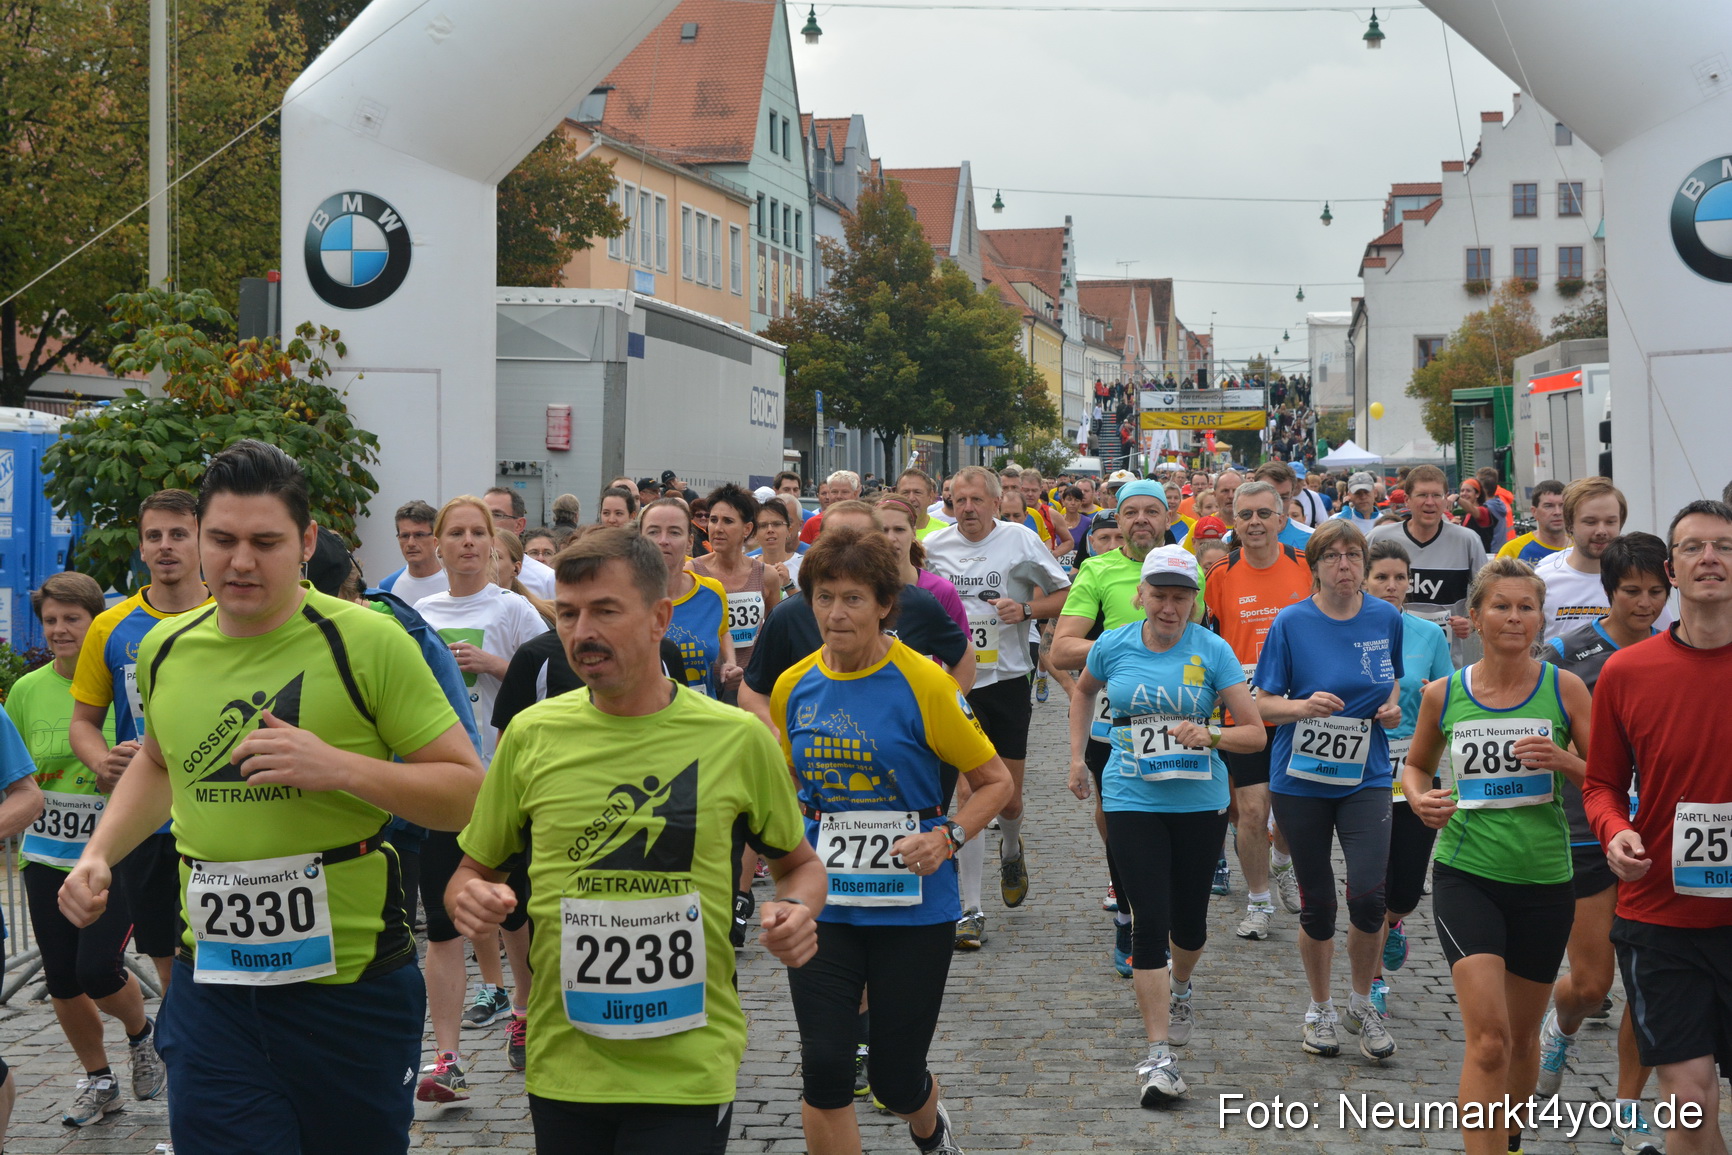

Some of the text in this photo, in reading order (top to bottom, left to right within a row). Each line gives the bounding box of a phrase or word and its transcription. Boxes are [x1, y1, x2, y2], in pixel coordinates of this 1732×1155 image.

[311, 194, 403, 233] BMW
[751, 386, 779, 430] BOCK
[1181, 415, 1224, 426] START
[949, 574, 984, 586] Allianz
[1405, 572, 1444, 600] sky
[1239, 595, 1257, 605] DAK
[1130, 684, 1202, 713] ANY
[1133, 715, 1158, 726] PARTL
[1299, 717, 1359, 732] PARTL Neumarkt
[1140, 725, 1204, 755] 21
[1455, 727, 1534, 740] PARTL Neumarkt
[183, 714, 238, 774] GOSSEN
[1300, 729, 1363, 760] 2267
[1149, 757, 1199, 771] Hannelore
[1462, 740, 1540, 775] 289
[1316, 763, 1338, 776] Anni
[1484, 781, 1524, 796] Gisela
[53, 799, 91, 810] Neumarkt
[33, 808, 97, 839] 3394
[822, 820, 902, 831] PARTL Neumarkt
[1677, 812, 1710, 823] PARTL
[567, 799, 628, 863] GOSSEN
[1684, 827, 1732, 862] 25
[192, 869, 299, 886] PARTL Neumarkt
[577, 877, 692, 894] METRAWATT
[832, 878, 904, 893] Rosemarie
[201, 886, 316, 938] 2330
[565, 911, 680, 928] PARTL Neumarkt
[231, 949, 293, 968] Roman
[576, 929, 694, 985] 2238
[567, 980, 573, 989] D
[602, 1000, 668, 1023] Jürgen
